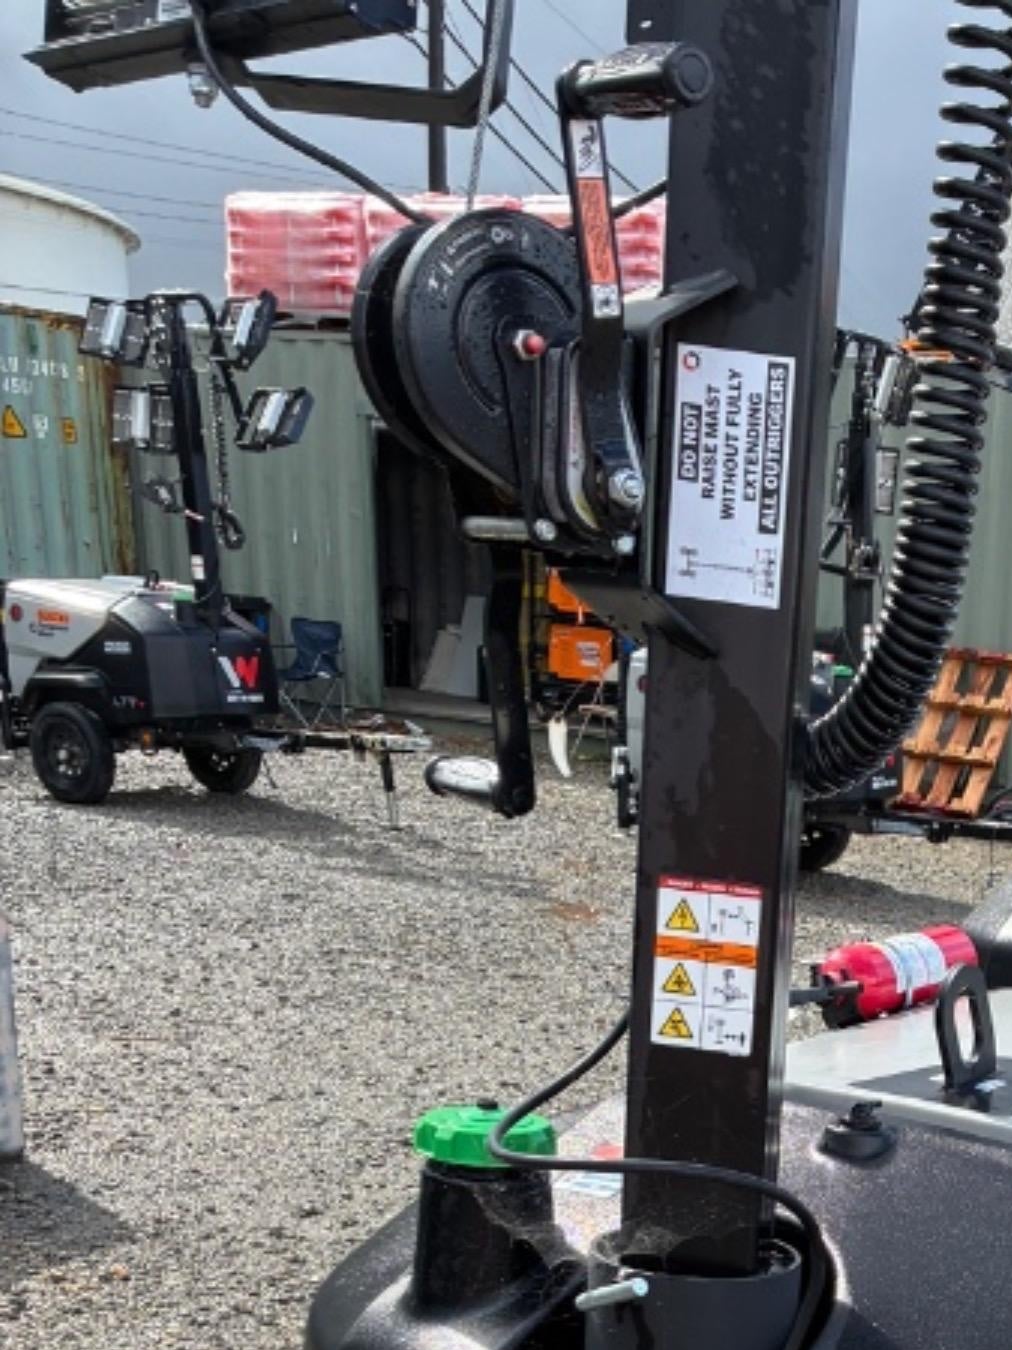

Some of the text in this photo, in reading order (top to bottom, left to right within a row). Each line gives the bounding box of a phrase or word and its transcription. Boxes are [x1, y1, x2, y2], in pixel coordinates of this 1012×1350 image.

[681, 405, 700, 479] DO NOT
[701, 384, 721, 499] RAISE MAST
[720, 368, 743, 520] WITHOUT FULLY
[743, 392, 763, 503] EXTENDING
[761, 367, 787, 529] ALL OUTRIGGERS
